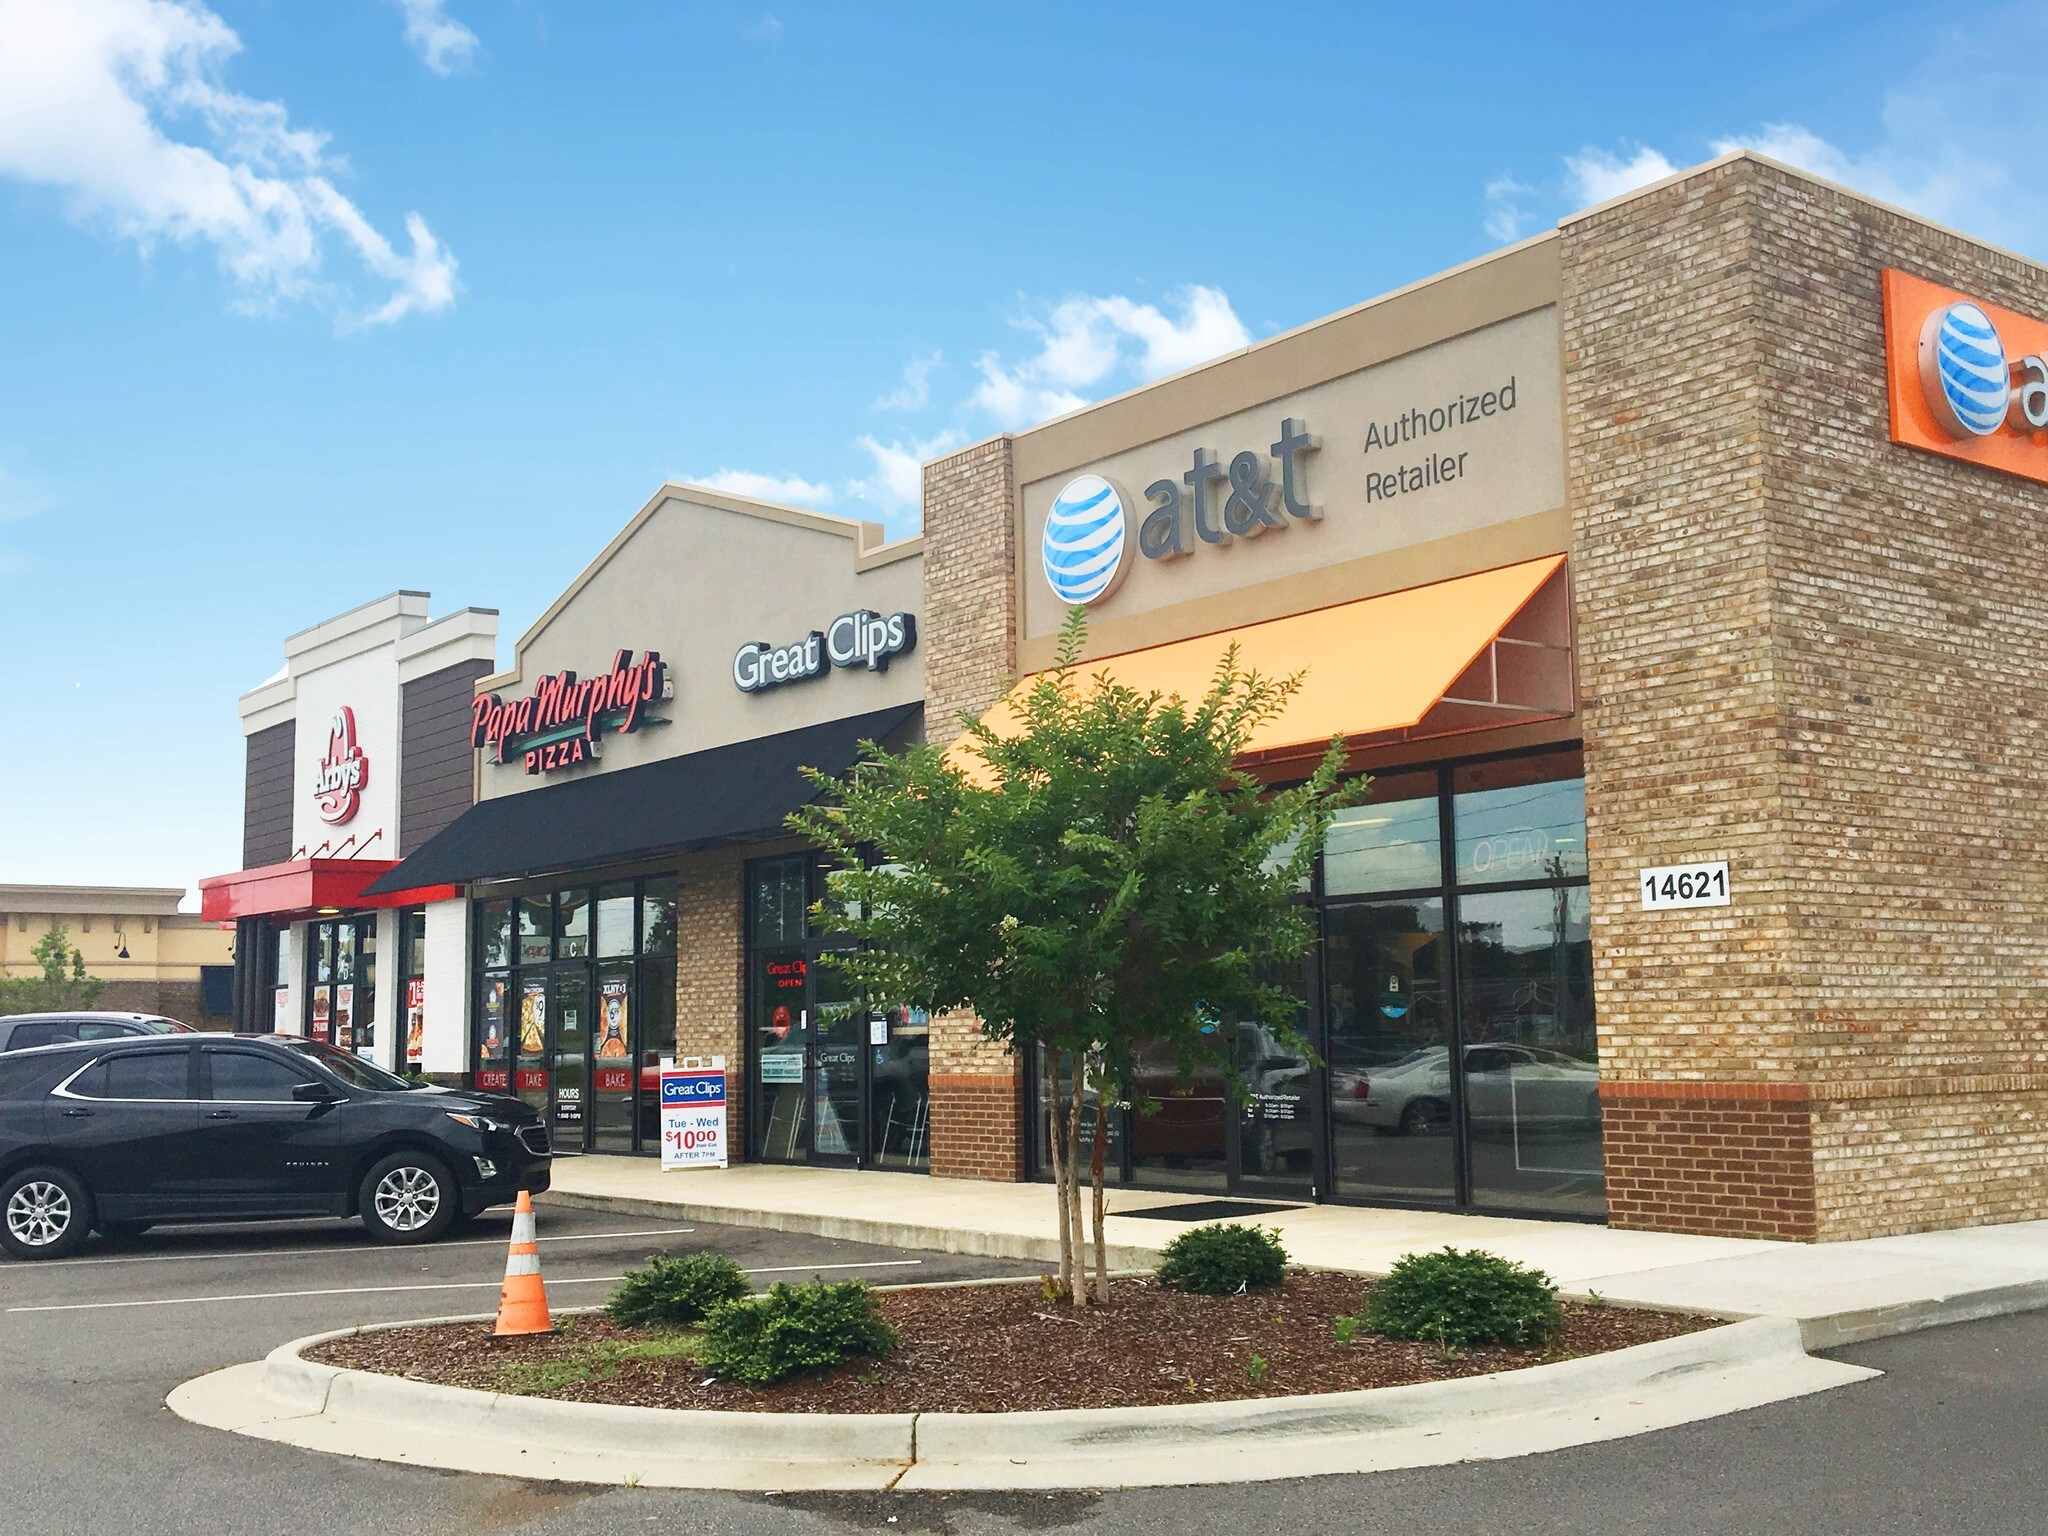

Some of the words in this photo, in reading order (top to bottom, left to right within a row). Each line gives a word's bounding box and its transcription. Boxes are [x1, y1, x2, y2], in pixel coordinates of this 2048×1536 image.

[1364, 376, 1517, 453] Authorized
[1365, 450, 1469, 503] Retailer
[1139, 417, 1320, 561] at&t
[734, 635, 820, 689] Great
[828, 611, 905, 668] Clips
[471, 692, 532, 764] Papa
[535, 649, 658, 742] Murphy's
[526, 738, 584, 774] PIZZA
[314, 747, 362, 799] Arby's
[1473, 828, 1549, 872] OPEN
[1645, 869, 1726, 902] 14621
[569, 941, 578, 958] C
[766, 962, 791, 975] Great
[778, 978, 803, 988] OPEN
[820, 1053, 839, 1062] Great
[840, 1053, 856, 1064] Clips
[483, 1073, 507, 1087] CREATE
[525, 1073, 543, 1087] TAKE
[605, 1073, 626, 1087] BAKE
[558, 1087, 580, 1099] HOURS
[664, 1083, 695, 1096] Great
[695, 1081, 721, 1098] Clips
[668, 1119, 687, 1128] Tue
[696, 1117, 718, 1127] Wed
